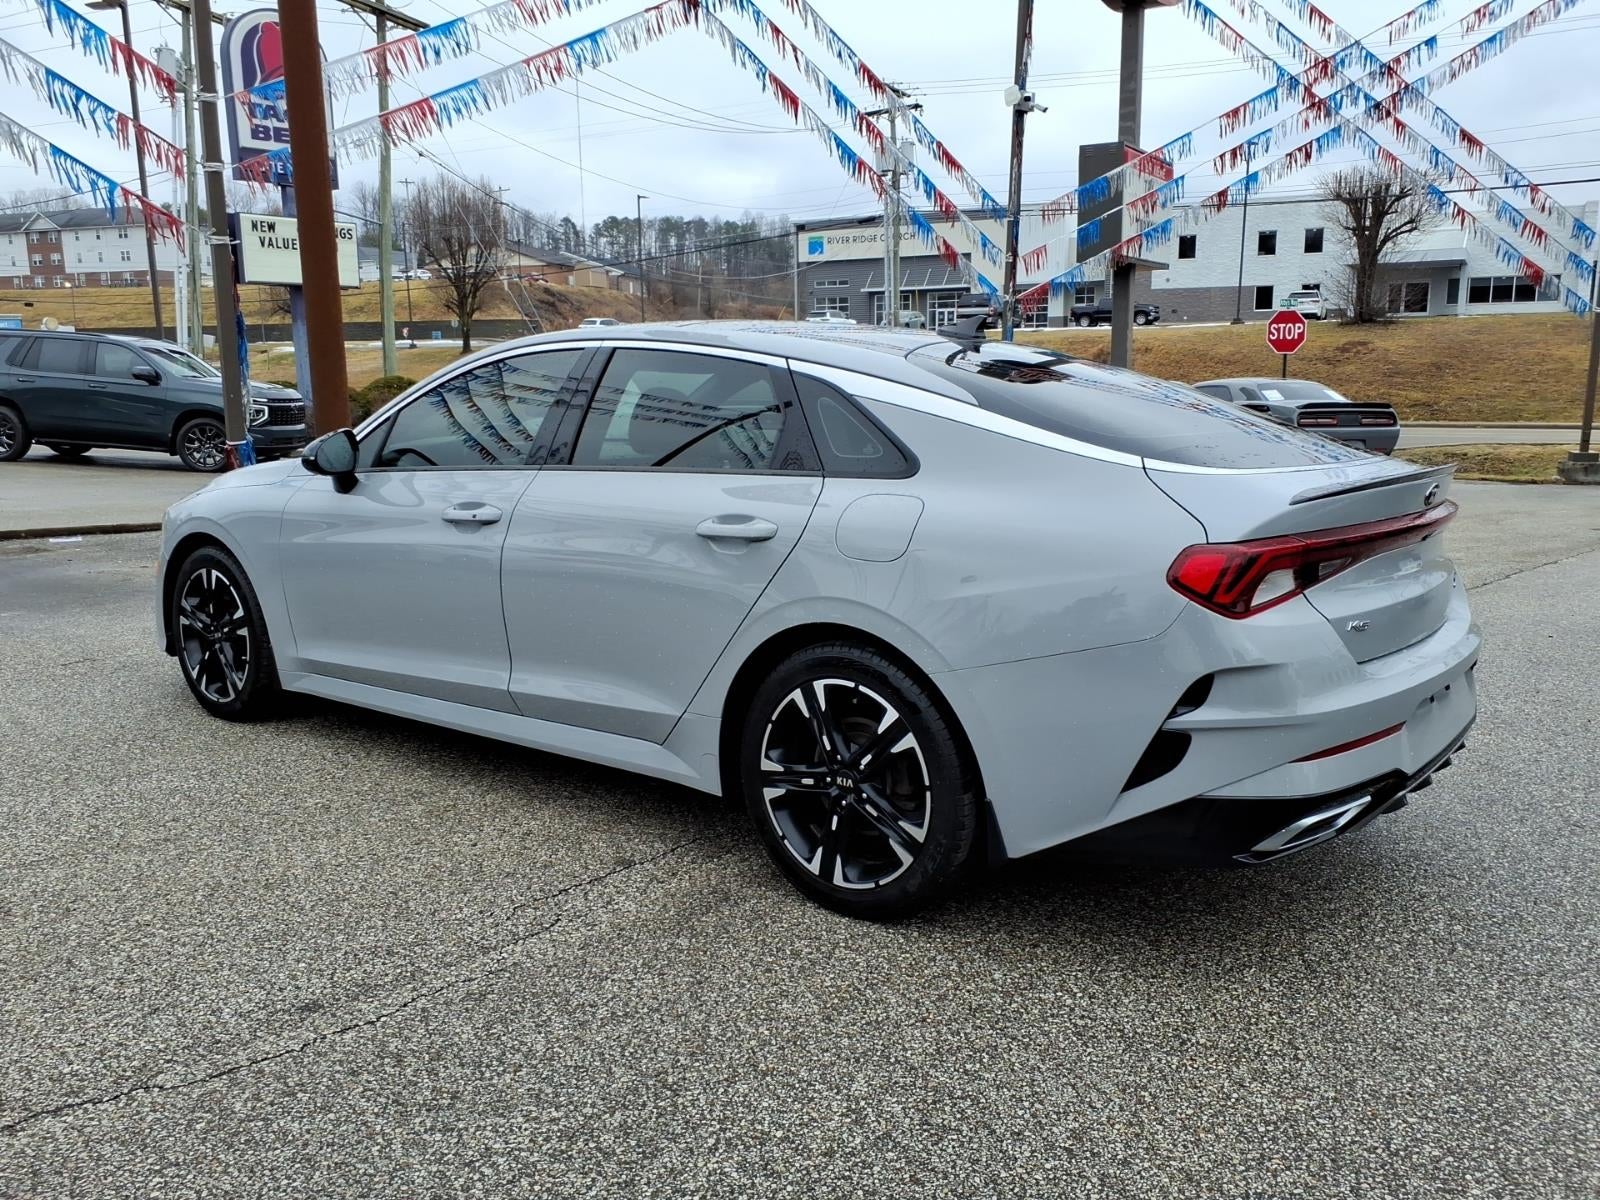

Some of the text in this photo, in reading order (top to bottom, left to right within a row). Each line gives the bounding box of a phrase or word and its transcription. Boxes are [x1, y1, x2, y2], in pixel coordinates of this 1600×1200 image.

[250, 124, 290, 143] BE
[251, 220, 276, 233] NEW
[827, 232, 915, 244] RIVER RIDGE CRCH
[1269, 323, 1304, 340] STOP
[837, 776, 853, 788] KIA
